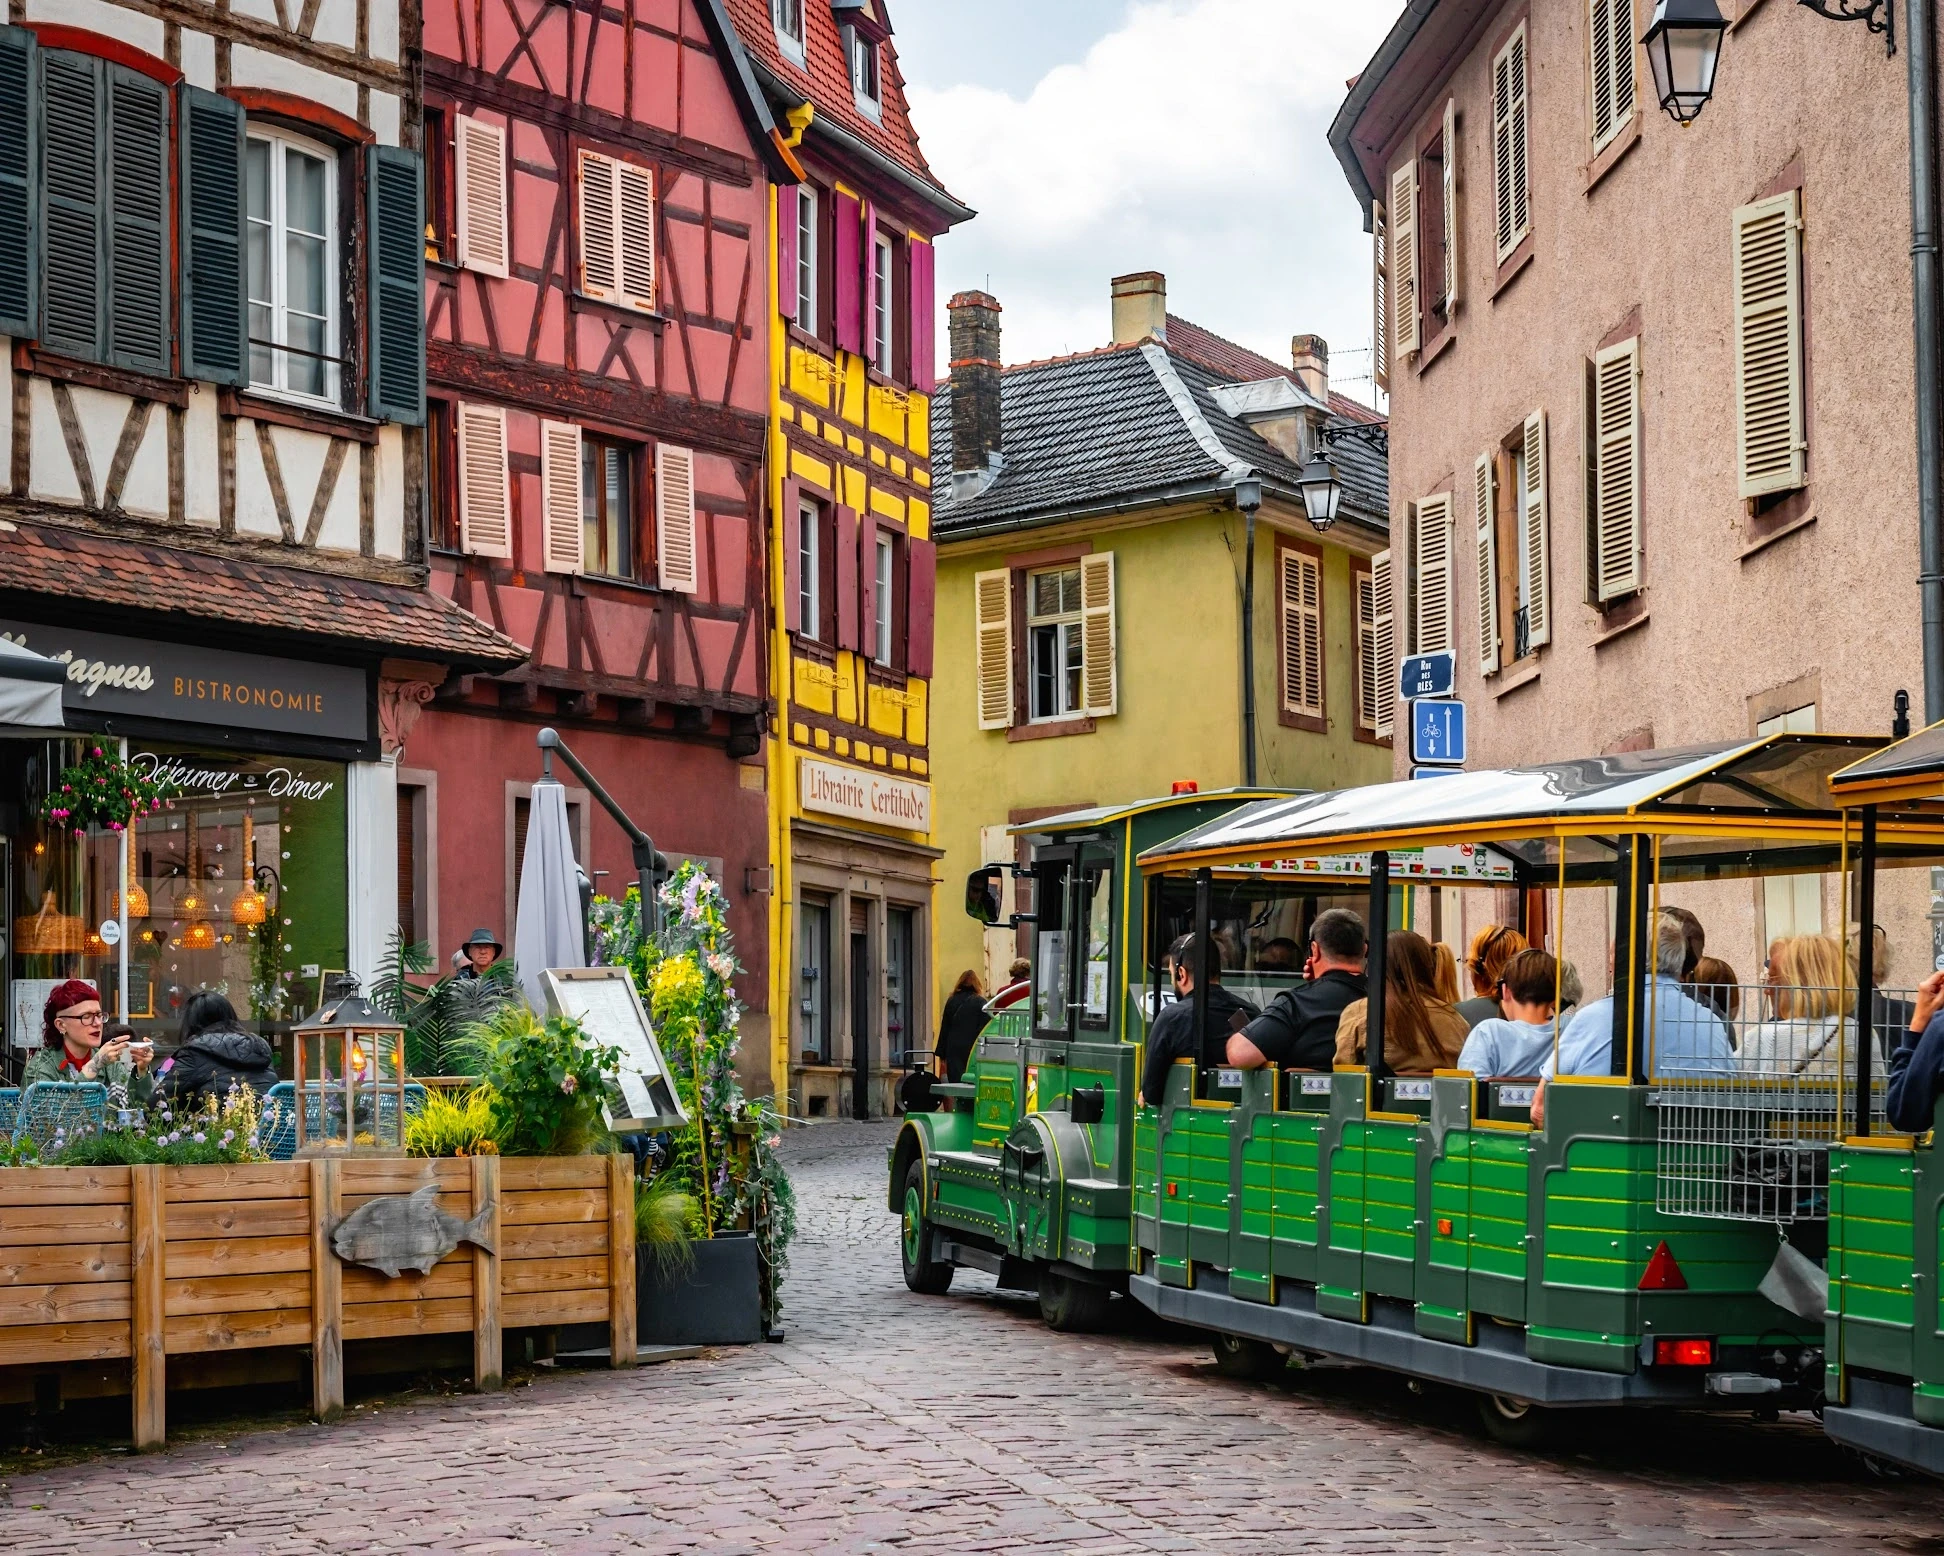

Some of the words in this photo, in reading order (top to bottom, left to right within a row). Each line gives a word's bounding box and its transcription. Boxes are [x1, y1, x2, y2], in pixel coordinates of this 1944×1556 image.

[1421, 671, 1431, 679] DES
[174, 677, 323, 713] BISTRONOMIE
[131, 752, 239, 792] Déjeuner
[811, 767, 863, 808] Librairie
[871, 781, 924, 821] Certitude
